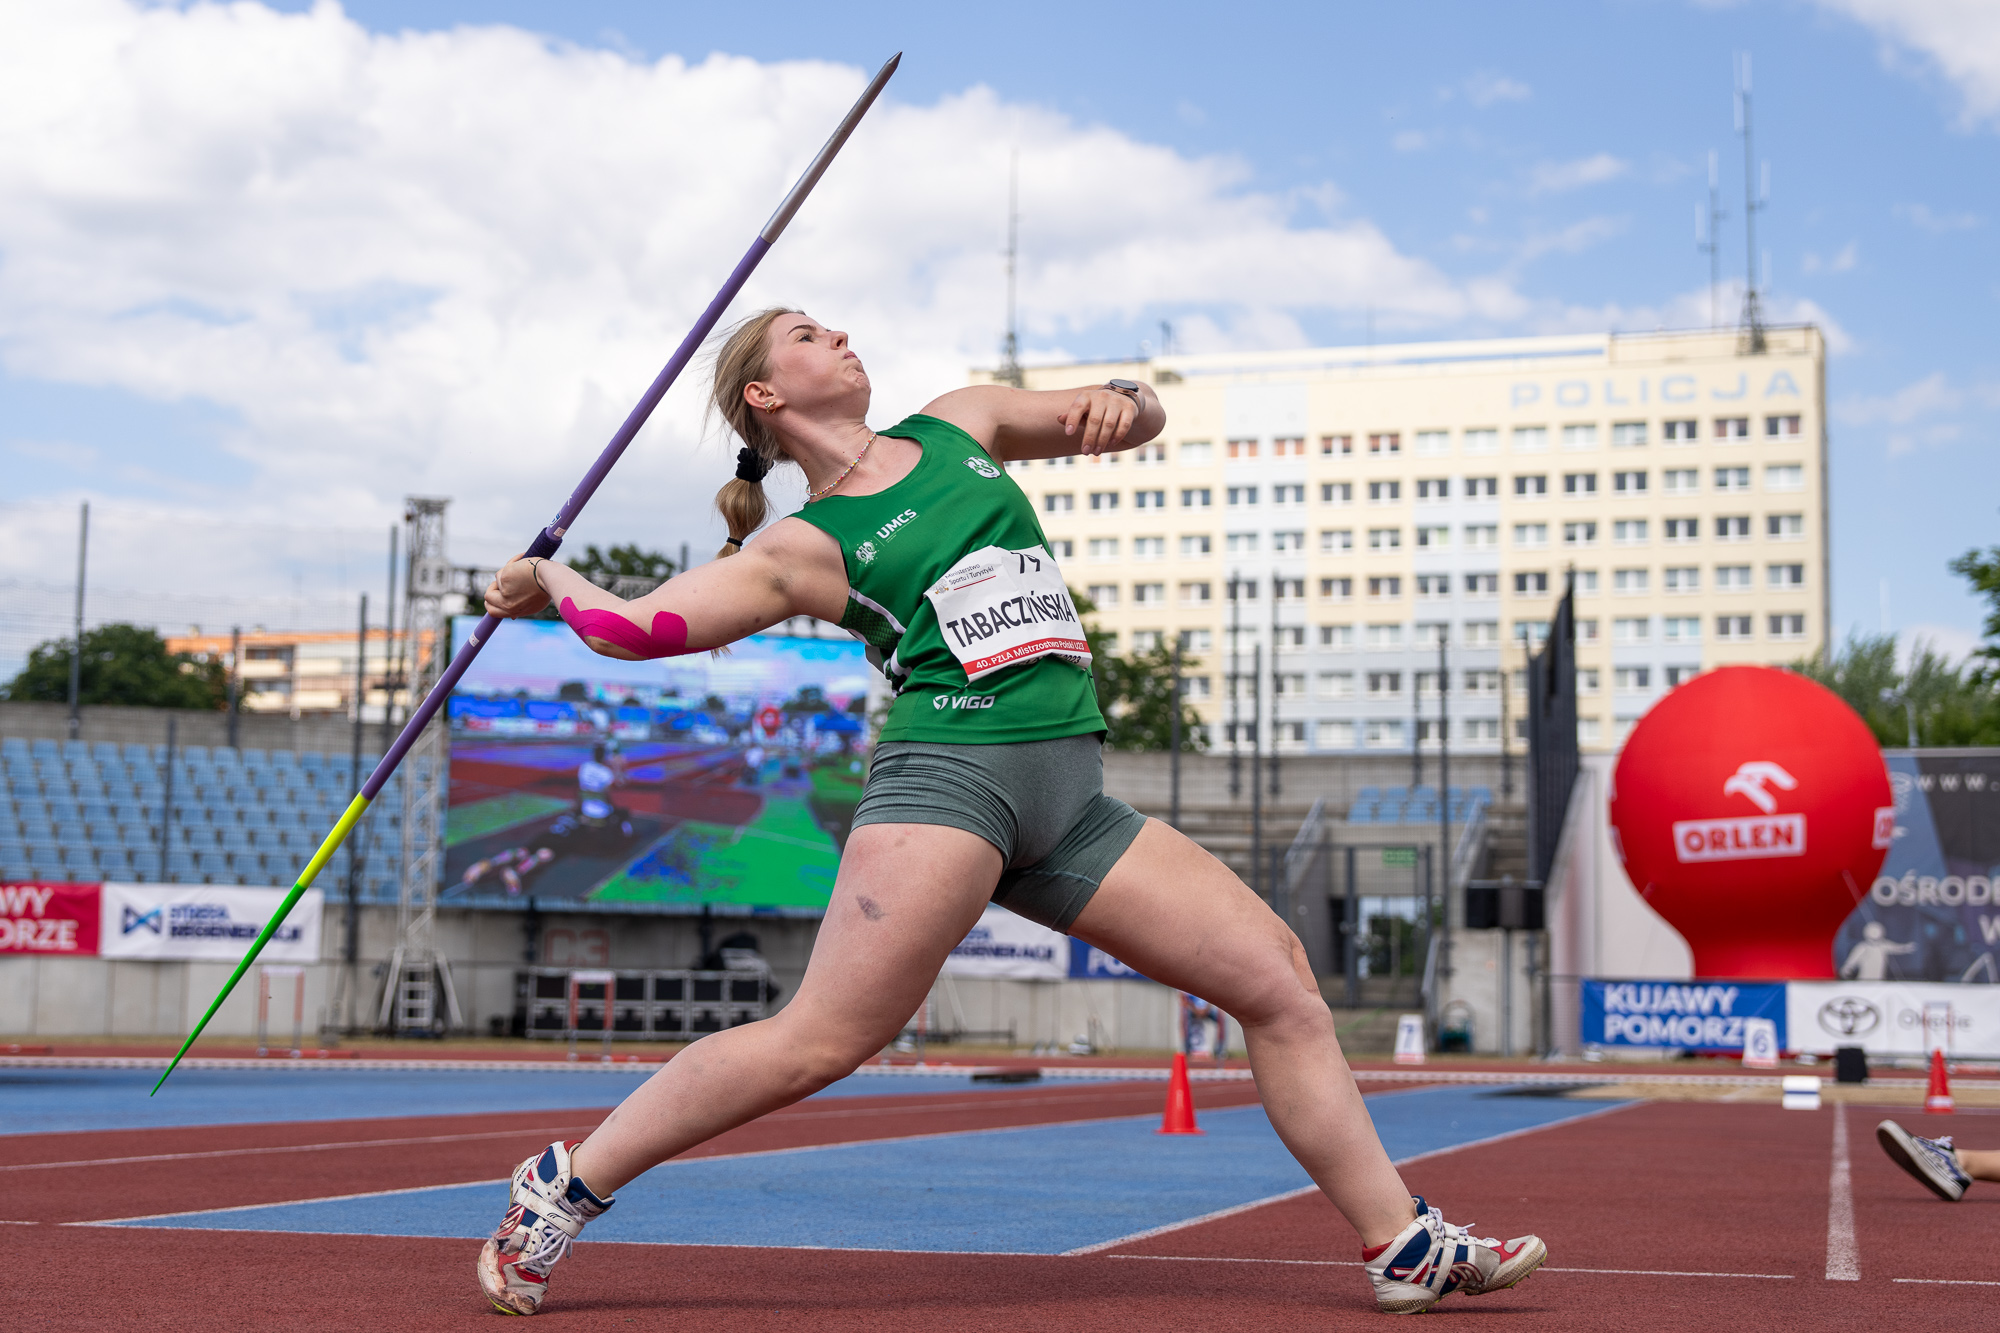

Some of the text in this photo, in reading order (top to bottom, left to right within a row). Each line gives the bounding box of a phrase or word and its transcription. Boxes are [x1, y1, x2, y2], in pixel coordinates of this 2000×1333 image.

[1510, 369, 1803, 409] POLICJA
[875, 508, 917, 539] UMCS
[944, 563, 981, 580] Ministerstwo
[948, 575, 967, 586] Sportu
[969, 565, 995, 579] Turystyki
[946, 590, 1076, 648] TABACZYŃSKA
[976, 660, 992, 669] 40.
[991, 653, 1014, 665] PZLA
[1013, 640, 1060, 658] Mistrzostwo
[1060, 640, 1075, 649] Polski
[1075, 641, 1085, 650] U23
[1684, 824, 1794, 852] ORLEN
[1603, 983, 1740, 1016] KUJAWY
[1603, 1014, 1746, 1047] POMORZ
